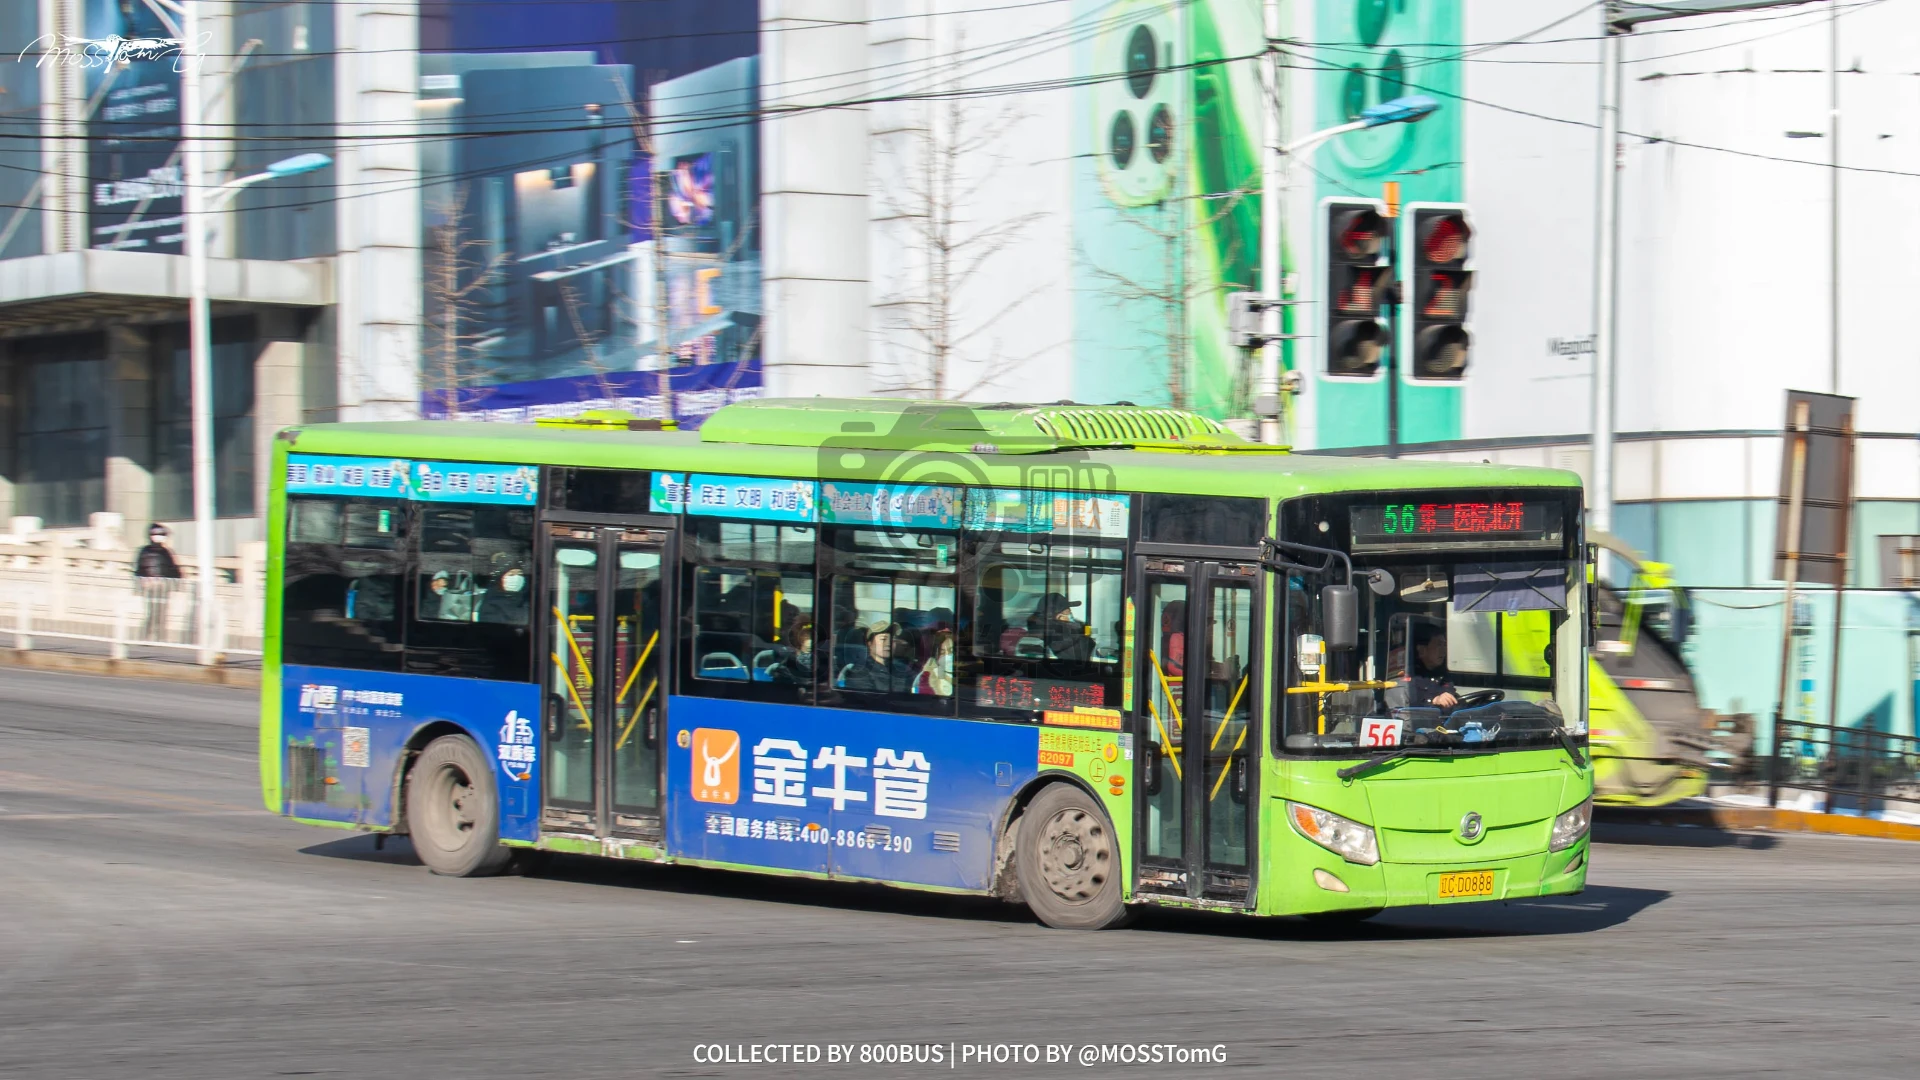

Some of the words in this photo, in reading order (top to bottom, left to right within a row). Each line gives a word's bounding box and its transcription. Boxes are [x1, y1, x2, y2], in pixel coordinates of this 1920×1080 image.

[734, 487, 762, 509] 文明
[1383, 504, 1415, 534] 56
[1367, 723, 1396, 747] 56
[1040, 751, 1072, 767] 62097
[752, 737, 931, 820] 金牛管
